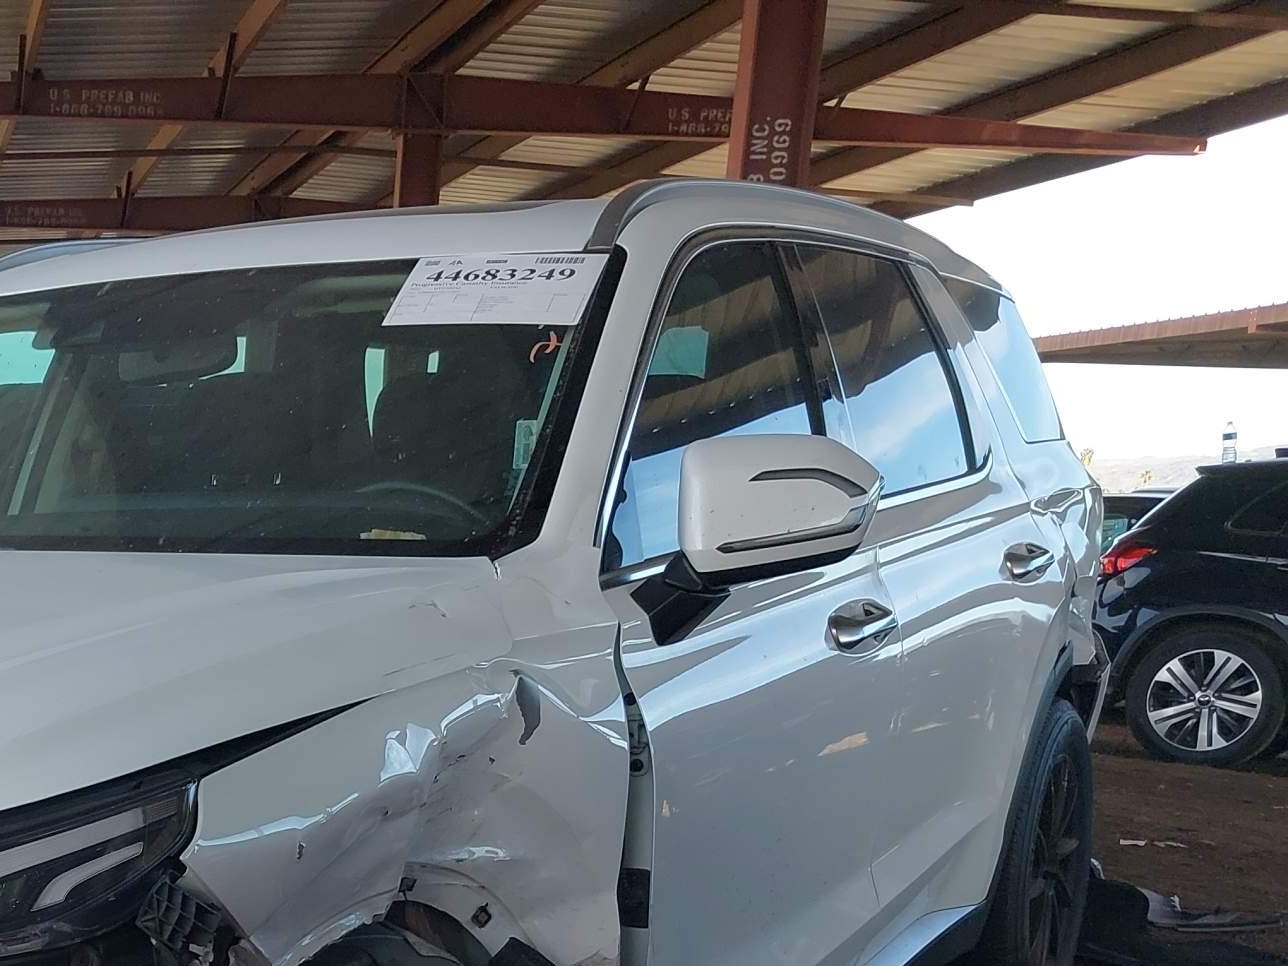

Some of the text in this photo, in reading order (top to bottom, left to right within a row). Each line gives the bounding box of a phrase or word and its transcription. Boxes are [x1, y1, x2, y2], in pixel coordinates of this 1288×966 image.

[82, 89, 135, 104] PREFAB
[749, 116, 771, 160] INC.
[425, 268, 577, 282] 44683249
